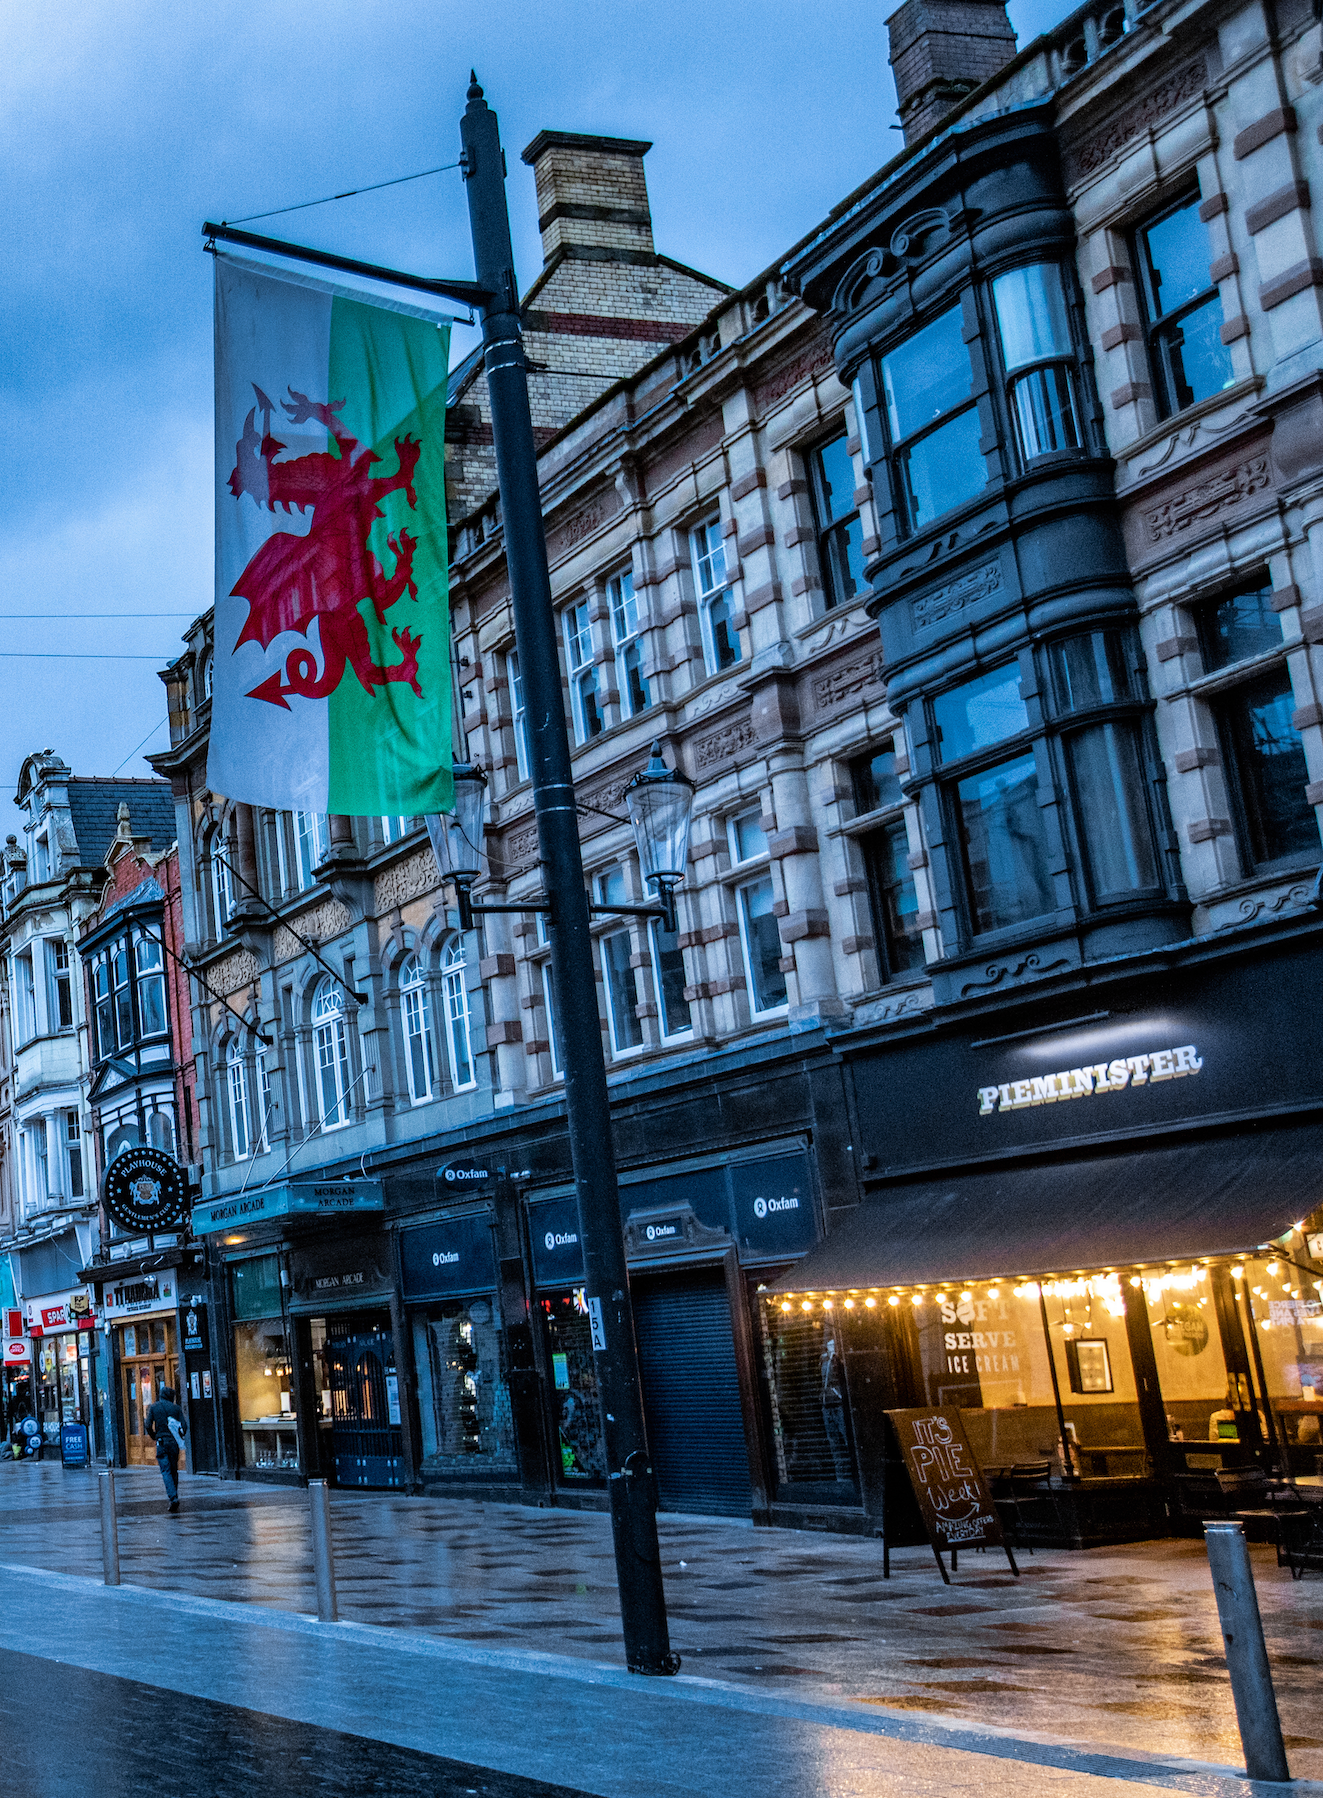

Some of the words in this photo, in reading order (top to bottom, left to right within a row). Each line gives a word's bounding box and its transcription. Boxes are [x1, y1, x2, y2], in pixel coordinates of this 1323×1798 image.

[978, 1045, 1203, 1114] PIEMINISTER
[121, 1160, 168, 1178] PLAYHOUSE
[456, 1169, 488, 1179] Oxfam
[314, 1187, 355, 1196] MORGAN
[159, 1202, 171, 1216] CLUB
[210, 1207, 237, 1222] MORGAN
[239, 1198, 265, 1215] ARCADE
[318, 1199, 355, 1207] ARCADE
[767, 1197, 798, 1212] Oxfam
[655, 1225, 675, 1236] Oxfam
[555, 1233, 577, 1245] Oxfam
[439, 1251, 459, 1263] Oxfam
[315, 1277, 339, 1289] MORGAN
[342, 1272, 364, 1285] ARCADE
[47, 1309, 66, 1324] SPAR
[944, 1331, 1016, 1350] SERVE
[947, 1355, 969, 1374] ICE
[975, 1354, 1020, 1373] CREAM
[912, 1416, 953, 1444] IT'S
[65, 1436, 83, 1444] FREE
[911, 1444, 973, 1483] PIE
[935, 1520, 972, 1533] AMAZING
[972, 1515, 995, 1527] OFFERS
